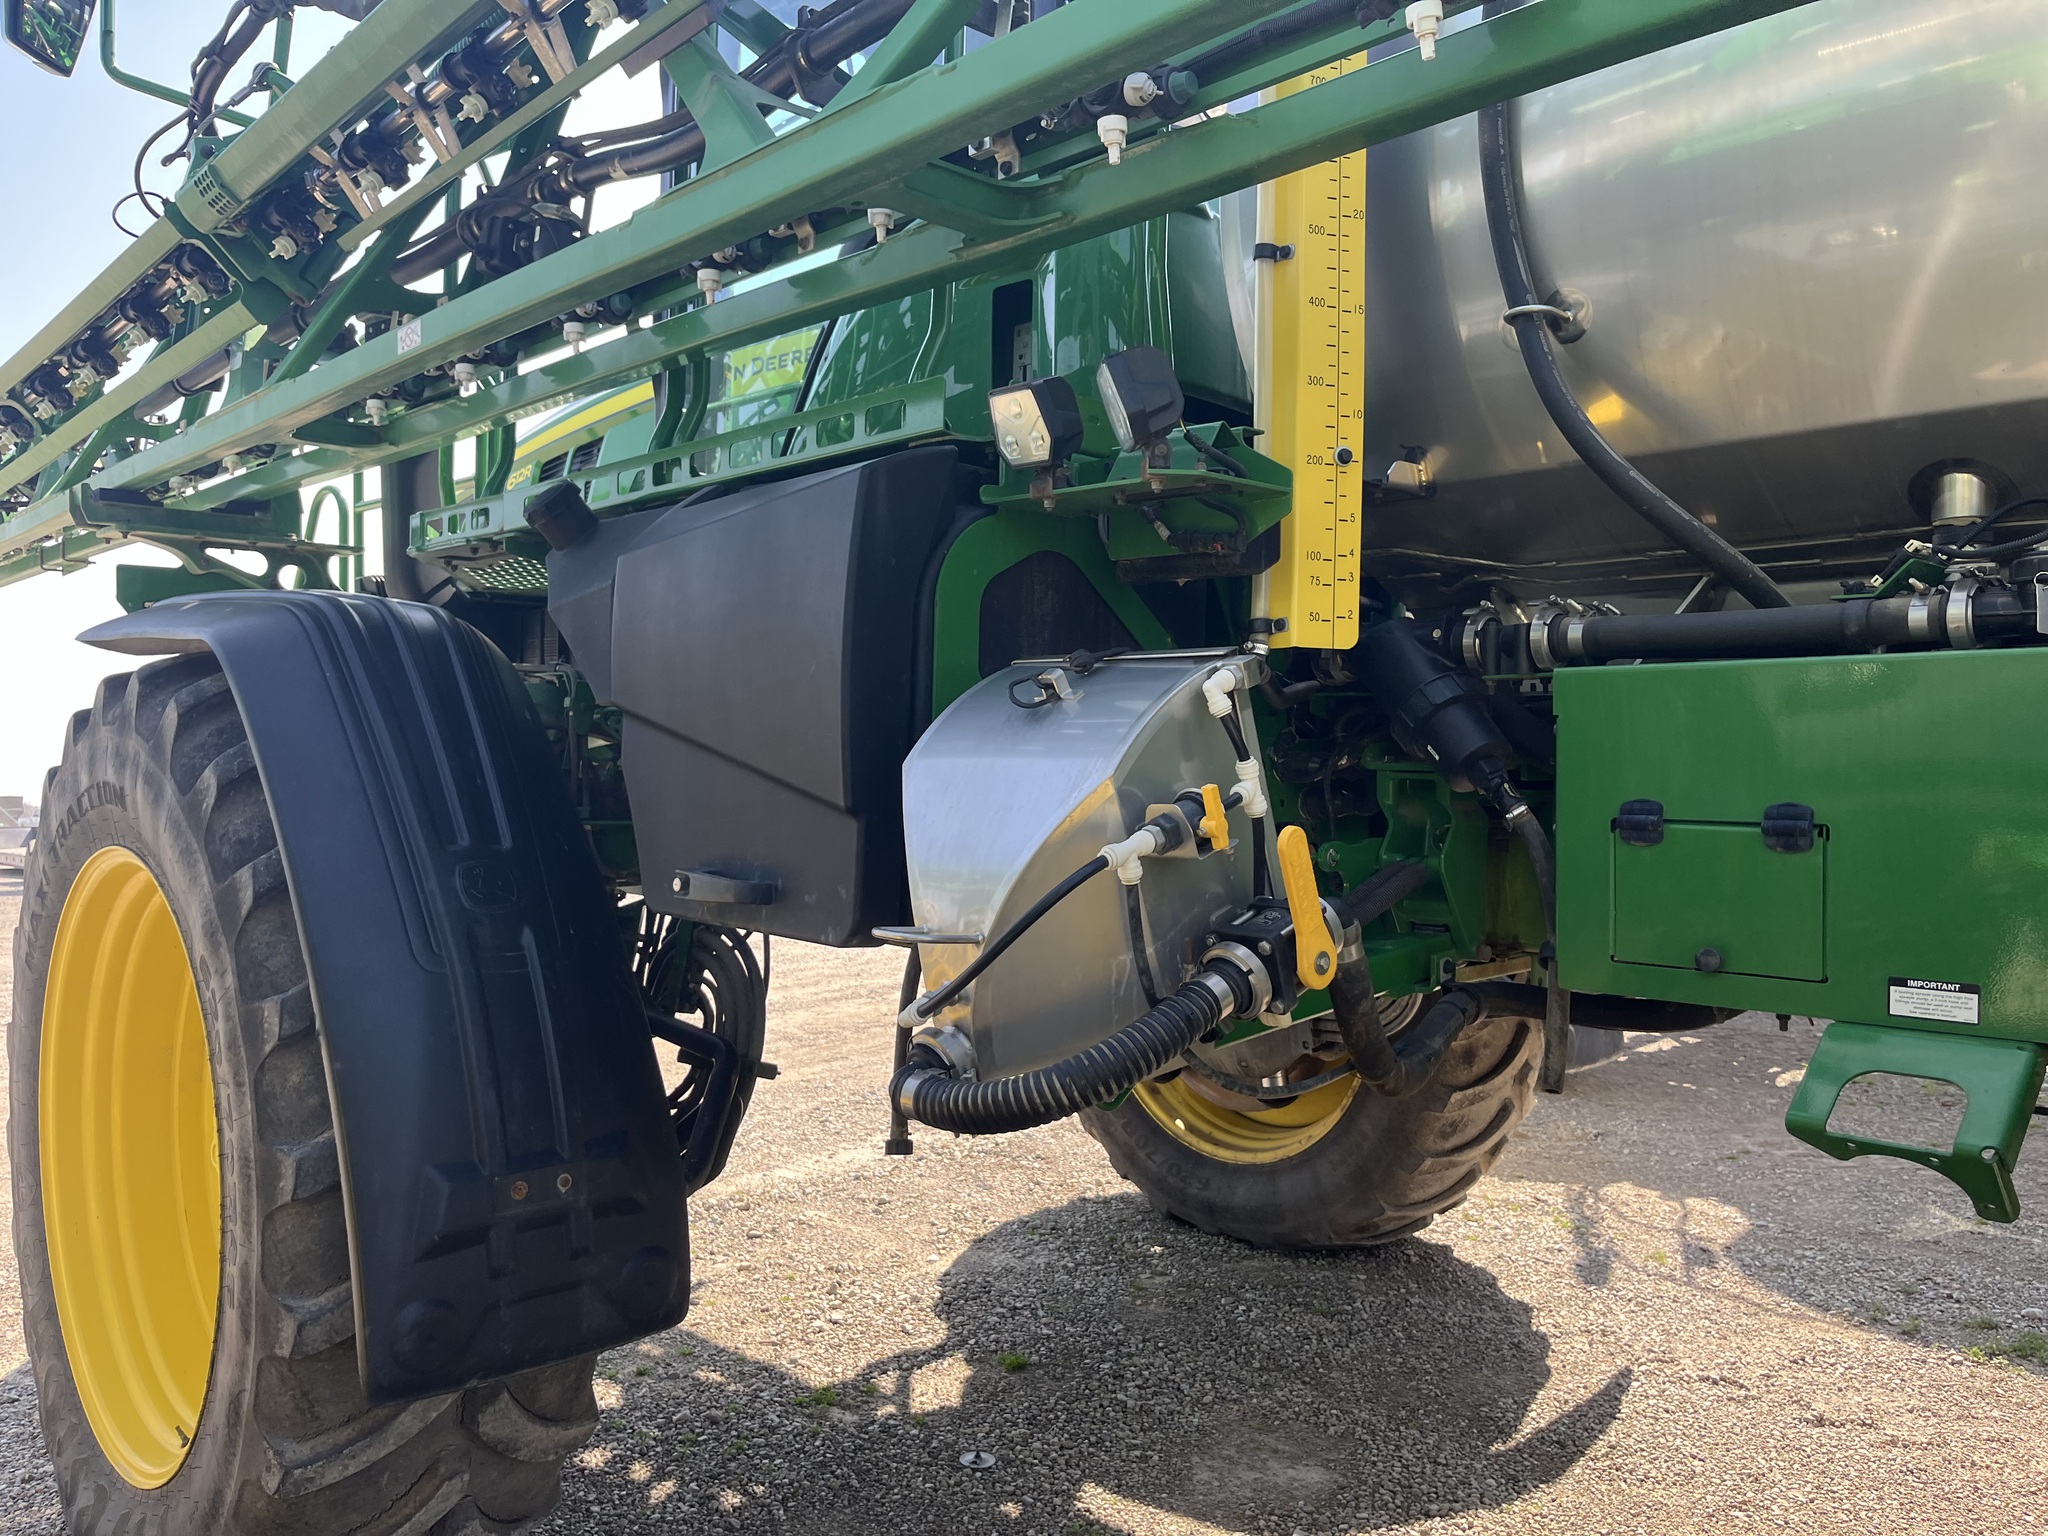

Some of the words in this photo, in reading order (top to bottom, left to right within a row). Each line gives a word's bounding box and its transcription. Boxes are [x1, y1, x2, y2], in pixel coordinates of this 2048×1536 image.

[1353, 208, 1364, 220] 20
[1308, 224, 1326, 236] 500
[1308, 297, 1326, 308] 400
[1354, 304, 1364, 315] 15
[1307, 375, 1324, 386] 300
[1352, 409, 1362, 420] 10
[1306, 455, 1324, 466] 200
[1350, 513, 1356, 523] 5
[1306, 551, 1322, 562] 100
[1348, 548, 1354, 558] 4
[1310, 576, 1320, 586] 75
[1348, 572, 1354, 582] 3
[1308, 612, 1320, 622] 50
[1348, 610, 1354, 620] 2
[48, 780, 128, 864] TRACTION
[1907, 980, 1960, 991] IMPORTANT
